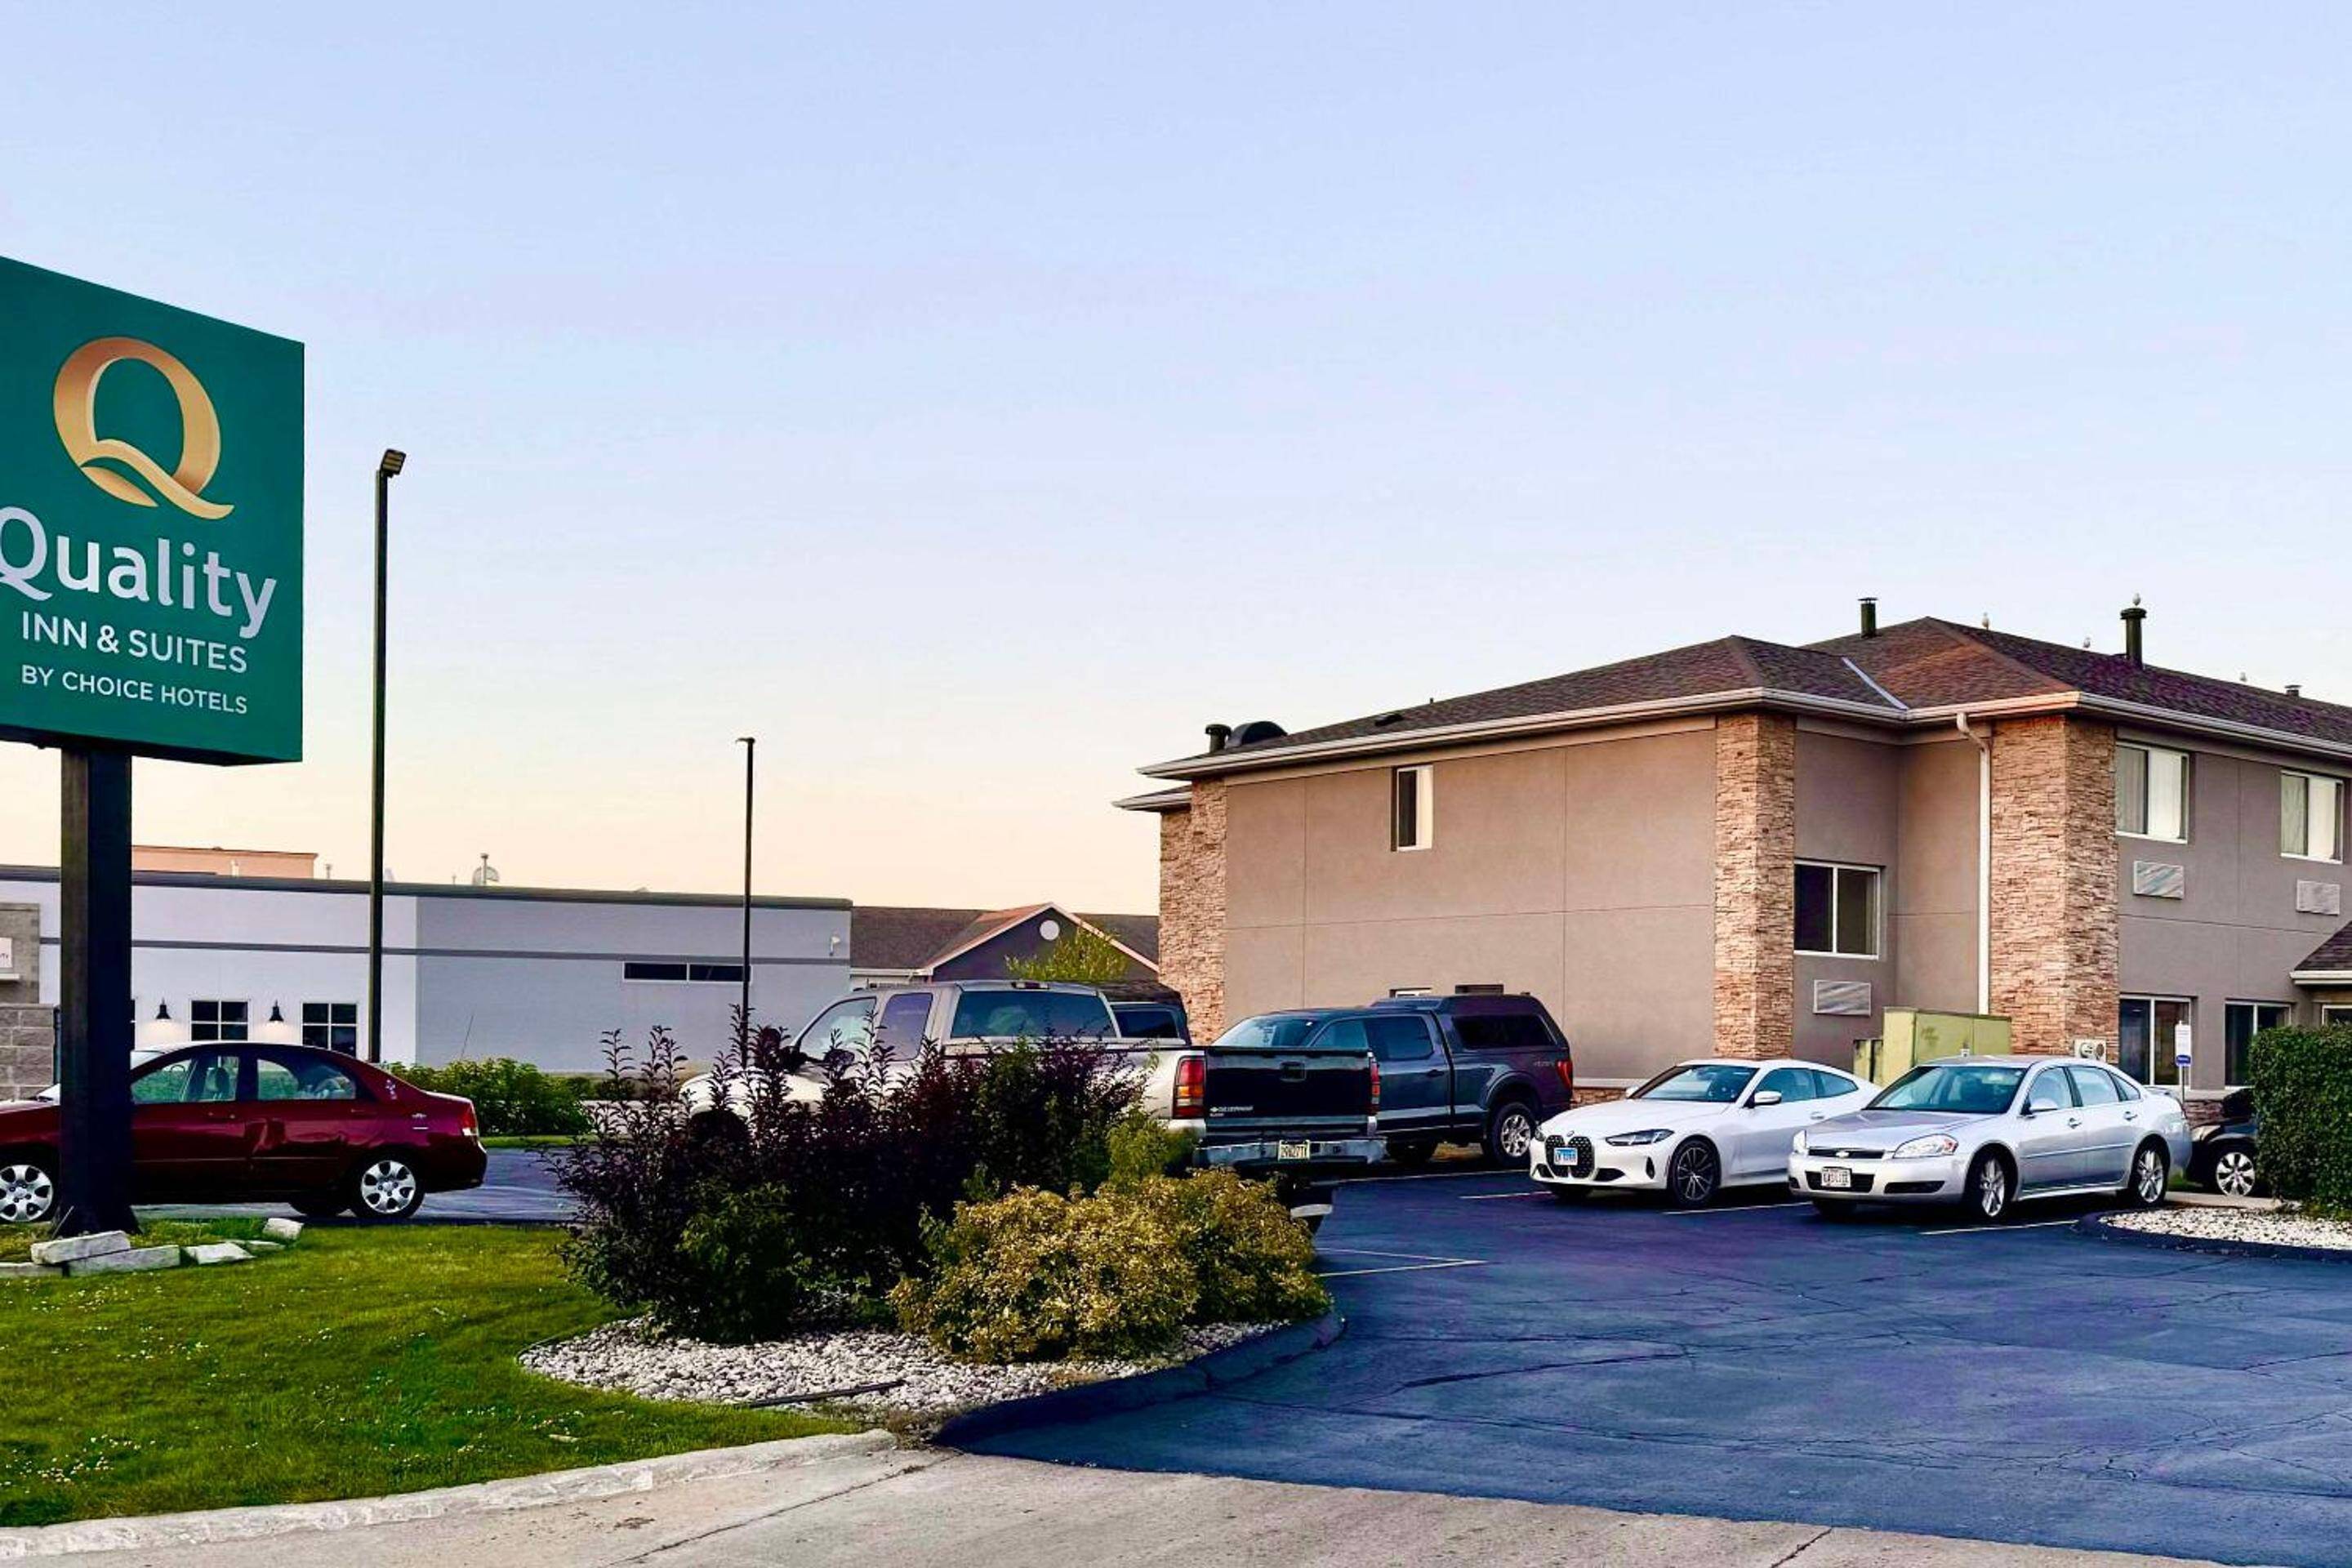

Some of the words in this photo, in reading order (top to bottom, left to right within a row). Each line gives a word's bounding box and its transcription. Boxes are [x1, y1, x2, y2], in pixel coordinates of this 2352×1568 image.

[53, 336, 234, 519] Q
[0, 506, 276, 638] Quality
[21, 611, 87, 649] INN
[96, 625, 120, 653] &
[128, 629, 247, 673] SUITES
[21, 664, 54, 686] BY
[61, 672, 154, 702] CHOICE
[162, 687, 247, 714] HOTELS
